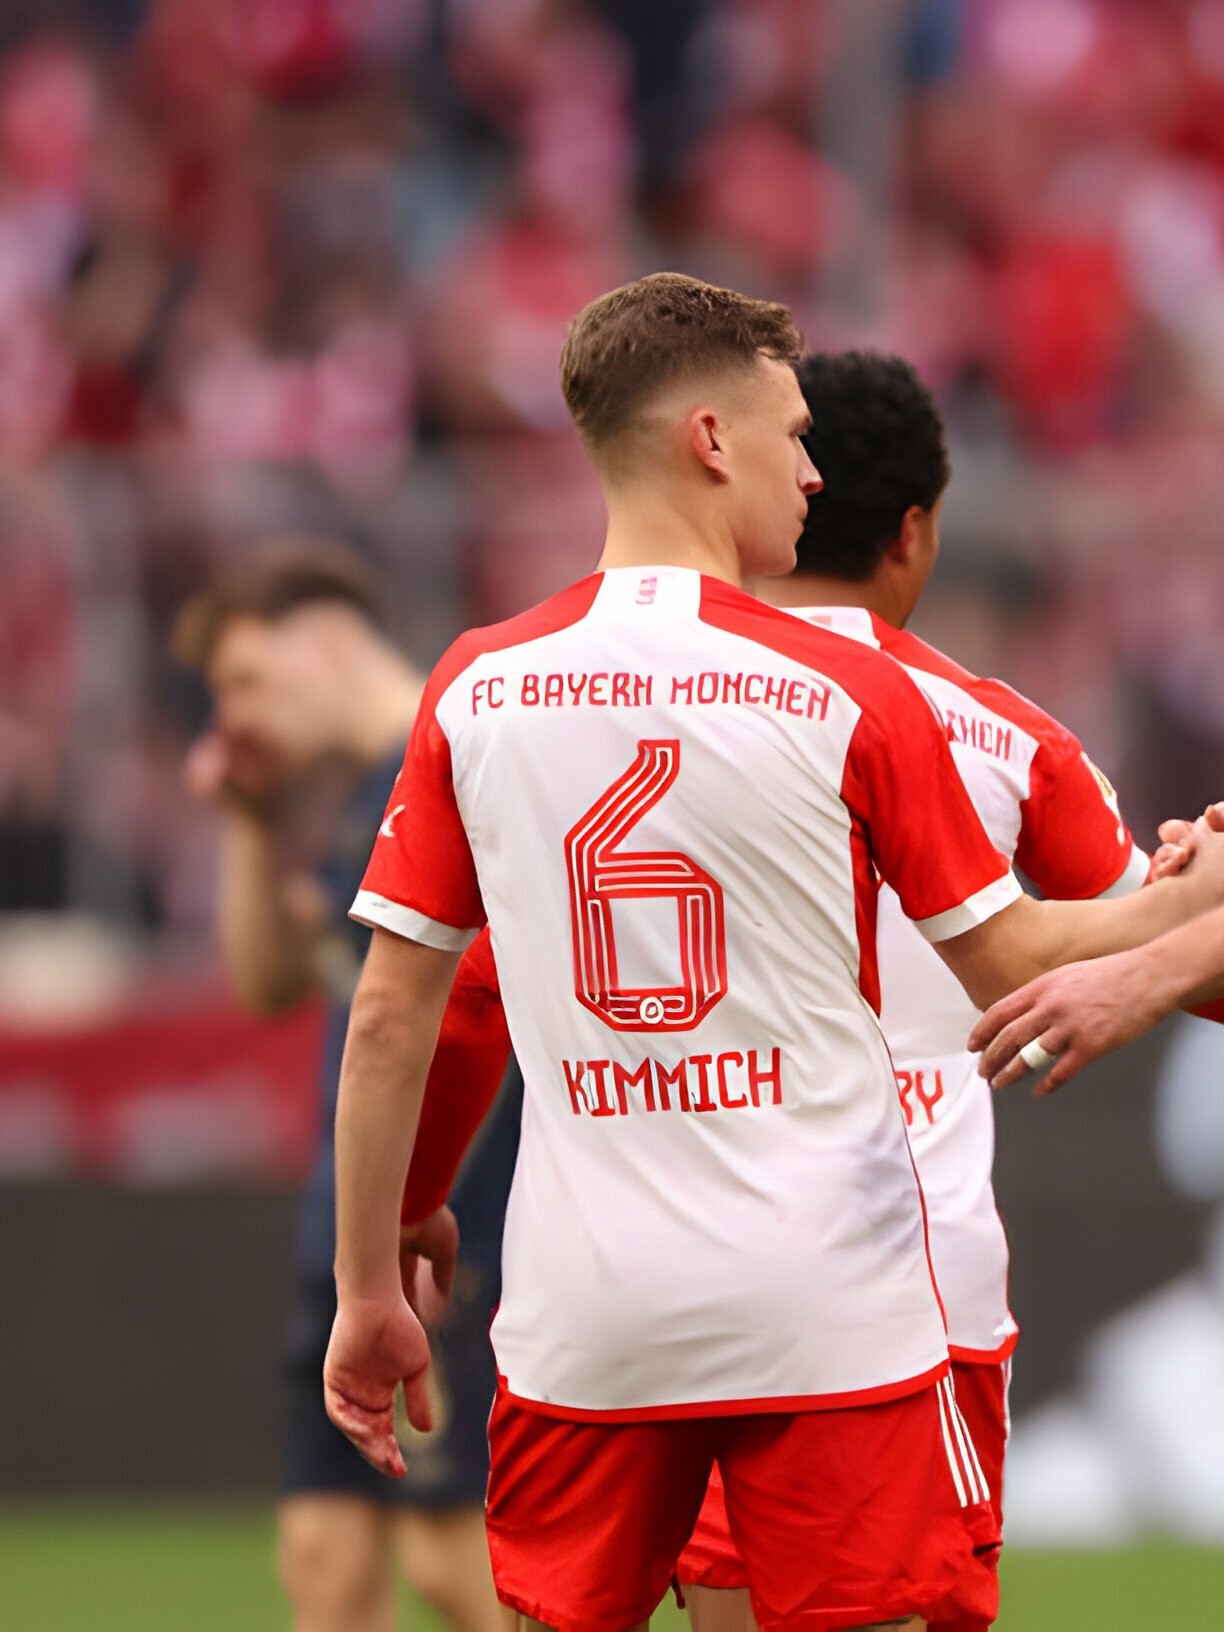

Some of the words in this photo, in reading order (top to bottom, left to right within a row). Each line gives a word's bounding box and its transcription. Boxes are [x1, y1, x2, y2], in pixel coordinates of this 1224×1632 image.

[472, 676, 505, 716] FC
[520, 672, 653, 707] BAYERN
[563, 739, 729, 1033] 6
[561, 1047, 783, 1117] KIMMICH
